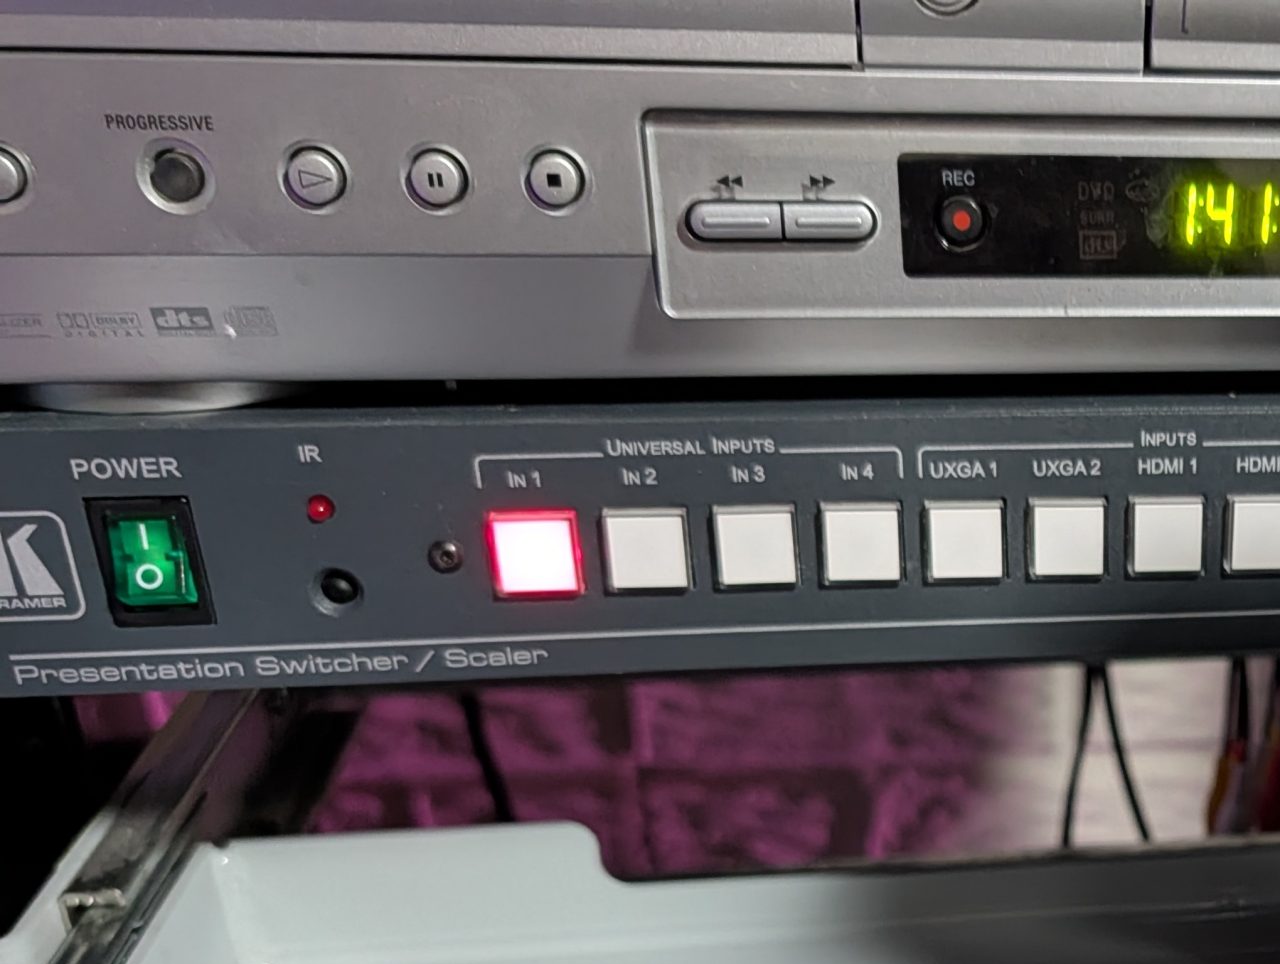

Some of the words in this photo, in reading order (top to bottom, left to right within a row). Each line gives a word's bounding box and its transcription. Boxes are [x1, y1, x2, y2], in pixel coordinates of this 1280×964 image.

[103, 113, 214, 132] PROGRESSIVE
[942, 169, 976, 187] REC
[155, 308, 210, 329] dts
[606, 438, 706, 457] UNIVERSAL
[712, 437, 776, 455] INPUTS
[1140, 430, 1198, 448] INPUTS
[298, 444, 323, 464] IR
[69, 456, 183, 481] POWER
[731, 466, 750, 483] IN
[752, 465, 766, 483] 3
[841, 463, 859, 481] IN
[860, 463, 875, 481] 4
[929, 460, 987, 480] UXGA
[988, 460, 998, 479] 1
[1032, 459, 1089, 478] UXGA
[1089, 458, 1101, 477] 2
[1137, 457, 1184, 476] HDMI
[1187, 457, 1198, 475] 1
[1236, 456, 1280, 474] HDMI
[507, 471, 527, 488] IN
[532, 471, 542, 488] 1
[622, 468, 643, 485] IN
[645, 468, 658, 485] 2
[14, 657, 246, 686] Presentation
[255, 651, 410, 677] Switcher
[444, 646, 549, 670] Scaler
